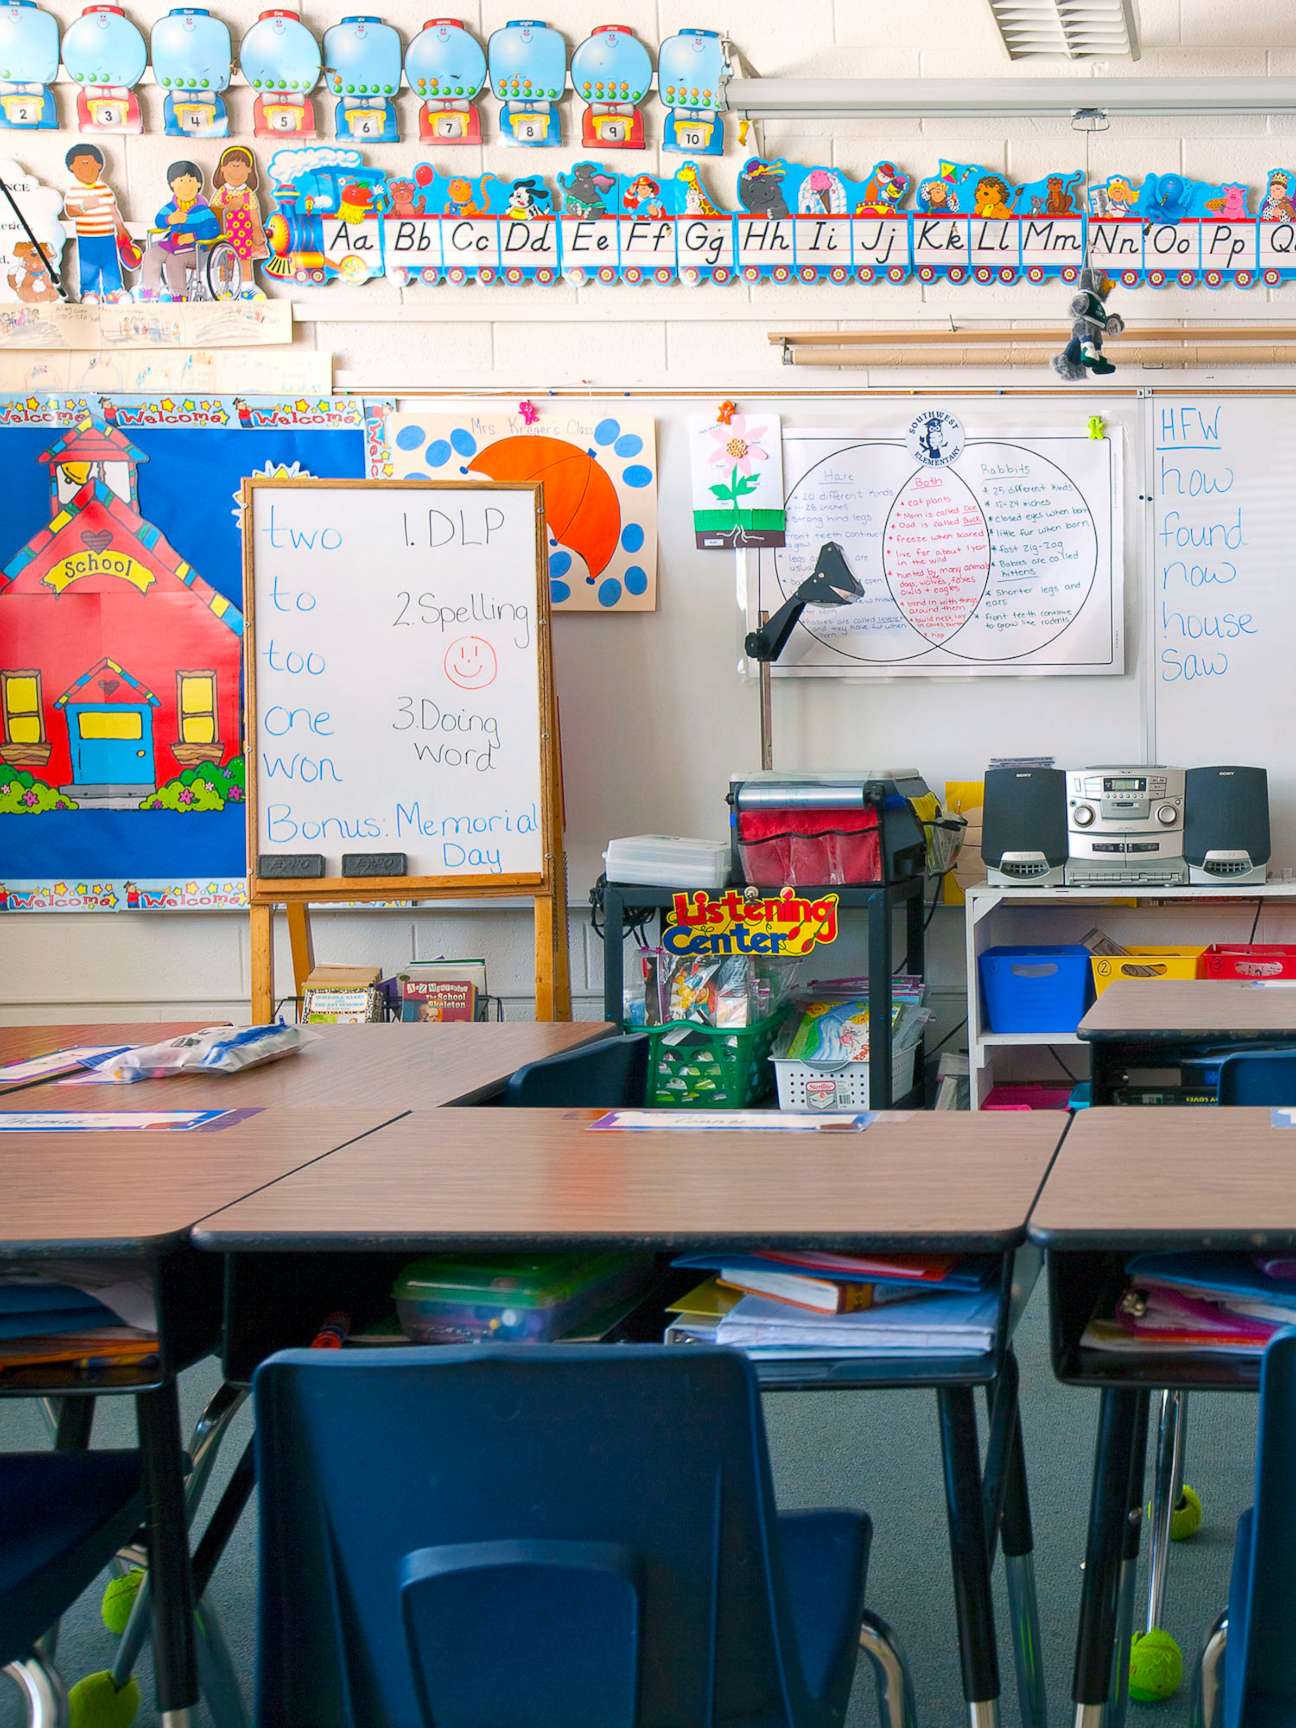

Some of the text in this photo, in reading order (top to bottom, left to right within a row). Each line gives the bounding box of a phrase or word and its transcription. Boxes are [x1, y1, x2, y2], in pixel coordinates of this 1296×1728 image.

[20, 109, 27, 120] 2
[105, 111, 112, 121] 3
[192, 116, 200, 128] 4
[281, 117, 288, 127] 5
[362, 122, 370, 133] 6
[445, 123, 453, 134] 7
[527, 125, 534, 137] 8
[609, 126, 617, 137] 9
[686, 132, 700, 146] 10
[330, 224, 373, 252] Aa
[394, 223, 432, 250] Bb
[451, 221, 490, 250] Cc
[504, 222, 551, 252] Dd
[625, 222, 668, 252] Ff
[685, 221, 724, 265] Gg
[861, 221, 897, 264] Jj
[916, 221, 965, 250] Kk
[1089, 224, 1139, 255] Nn
[1153, 224, 1190, 254] Oo
[1208, 225, 1247, 268] Pp
[119, 410, 223, 425] Welcome
[908, 410, 960, 435] SOUTHWEST
[1161, 406, 1221, 442] HFW
[913, 446, 961, 467] ELEMENTARY
[981, 463, 1031, 475] Rabbits
[914, 476, 943, 487] Both
[1161, 456, 1233, 497] how
[262, 505, 342, 551] two
[428, 508, 505, 548] DLP
[1158, 506, 1245, 550] found
[64, 553, 133, 579] School
[1161, 560, 1237, 590] now
[268, 576, 317, 612] to
[1161, 601, 1257, 640] house
[262, 639, 327, 676] too
[263, 705, 336, 737] one
[263, 752, 344, 784] won
[266, 800, 539, 844] Bonus: Memorial
[442, 842, 503, 876] Day
[12, 893, 111, 908] Welcome
[674, 890, 838, 942] Listening
[662, 925, 790, 956] Center
[437, 992, 466, 1001] School
